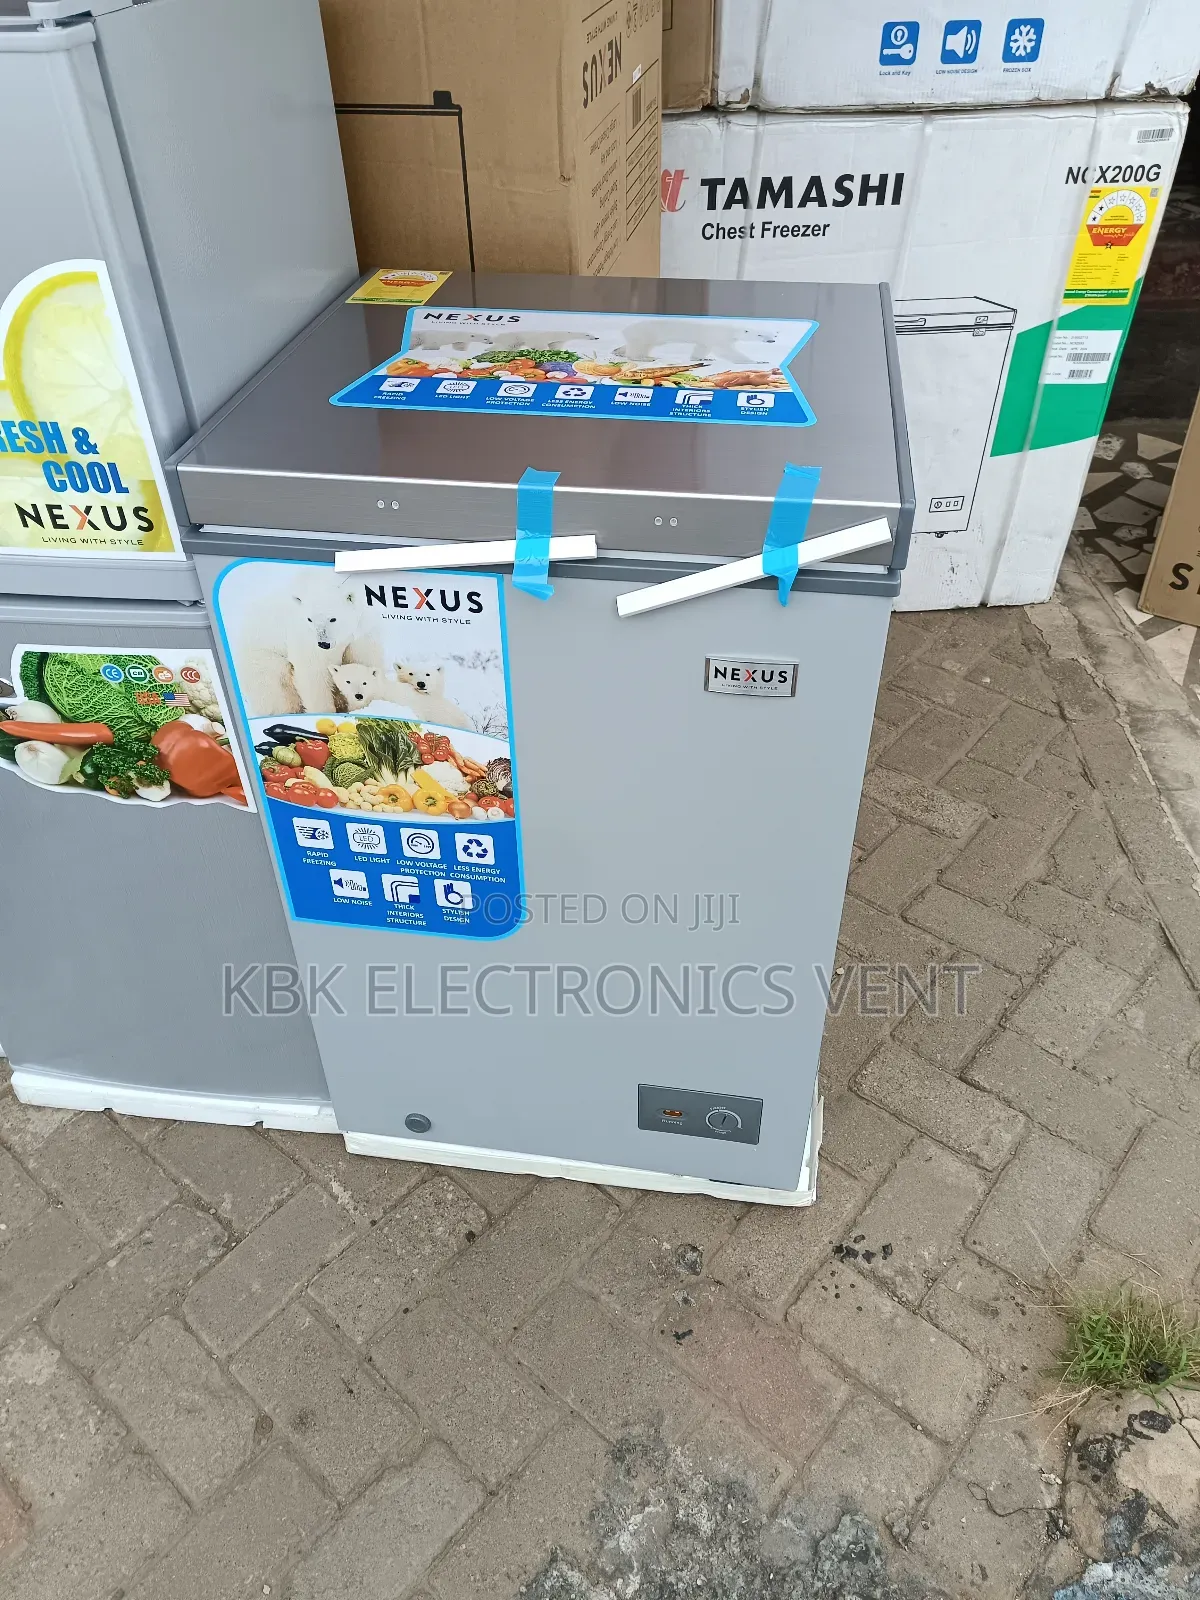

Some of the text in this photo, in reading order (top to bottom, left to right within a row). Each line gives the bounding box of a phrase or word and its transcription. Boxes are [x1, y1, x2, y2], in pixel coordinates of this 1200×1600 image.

[582, 31, 622, 109] NEXUS
[701, 172, 905, 211] TAMASHI
[702, 221, 831, 241] Chest Freezer
[1092, 227, 1128, 235] ENERGY
[423, 312, 521, 323] NEXUS
[72, 427, 100, 455] &
[41, 461, 130, 494] COOL
[14, 503, 155, 533] NEXUS
[41, 536, 145, 546] LIVING WITH STYLE
[364, 584, 484, 614] NEXUS
[382, 613, 472, 625] LIVING WITH STYLE
[713, 665, 788, 683] NEXUS
[359, 835, 374, 843] LED
[306, 850, 329, 858] RAPID
[302, 858, 337, 867] FREEZING
[354, 855, 391, 865] LED LIGHT
[396, 859, 448, 870] LOW VOLTAGE
[400, 867, 446, 877] PROTECTION
[453, 864, 501, 875] LESS ENERGY
[450, 872, 506, 884] CONSUMPTION
[333, 897, 373, 907] LOW NOISE
[393, 903, 415, 911] THICK
[386, 910, 424, 919] INTERIORS
[442, 908, 470, 916] STYLISH
[386, 917, 427, 926] STRUCTURE
[443, 915, 470, 924] DESIGN
